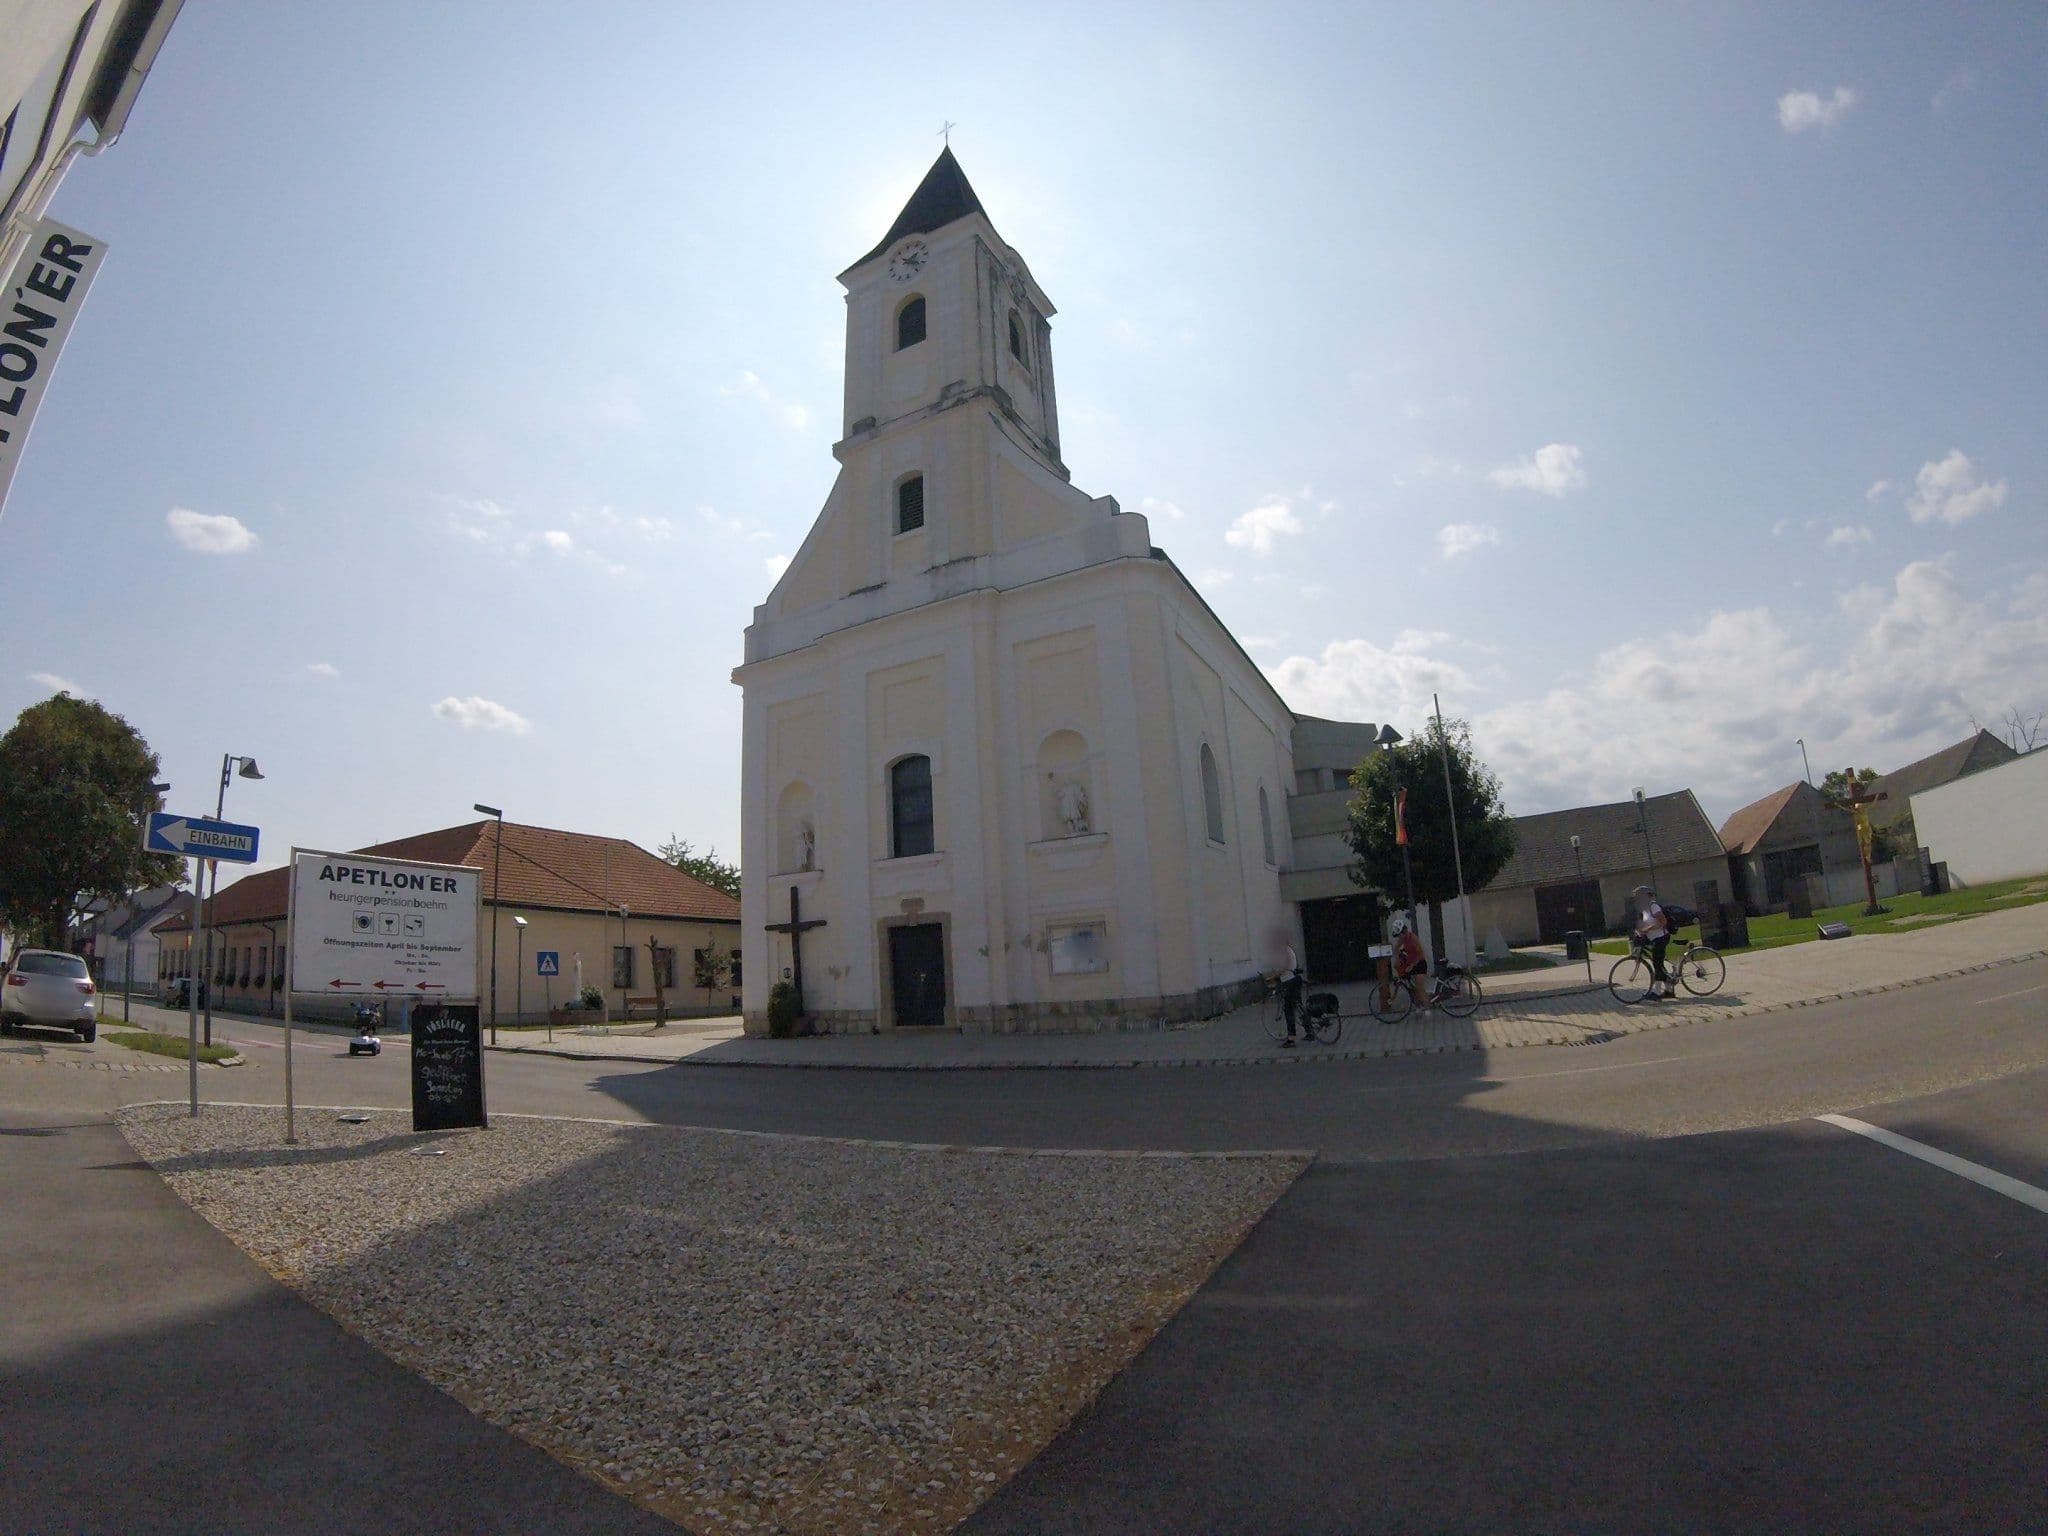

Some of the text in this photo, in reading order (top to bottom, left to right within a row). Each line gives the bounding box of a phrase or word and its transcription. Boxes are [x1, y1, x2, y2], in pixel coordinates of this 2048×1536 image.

[0, 233, 92, 443] LON'ER
[190, 830, 246, 849] EINBAHN
[323, 937, 384, 949] Öffnungszeiten
[386, 942, 405, 950] April
[420, 944, 462, 952] September
